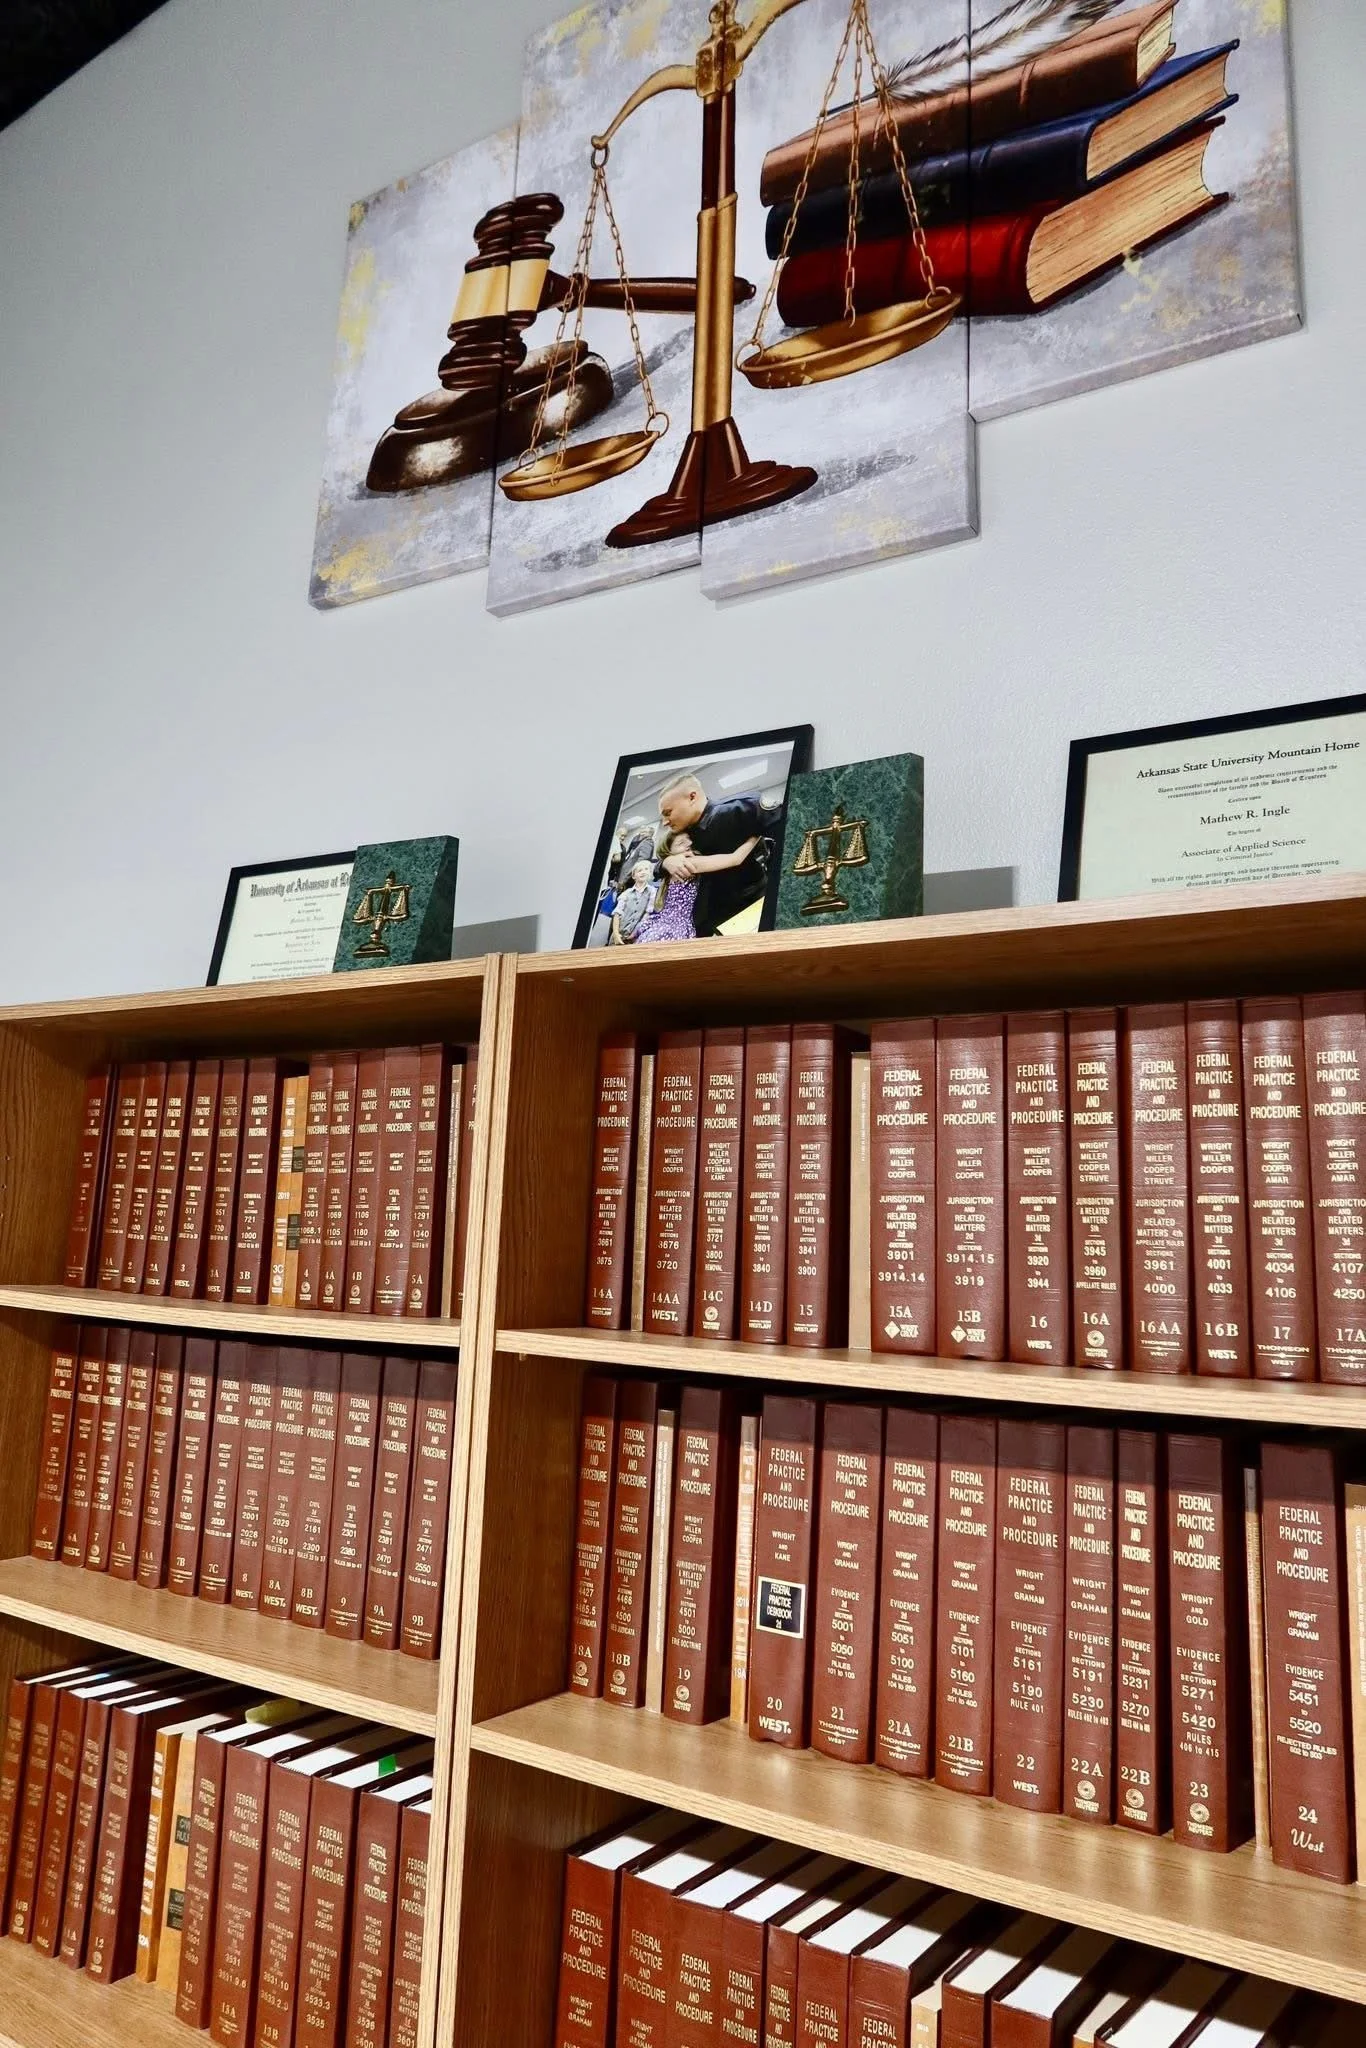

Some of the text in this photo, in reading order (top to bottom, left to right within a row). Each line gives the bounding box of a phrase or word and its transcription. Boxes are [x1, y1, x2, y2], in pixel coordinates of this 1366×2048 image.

[1136, 767, 1181, 779] Arkansas
[1183, 762, 1208, 773] State
[1211, 753, 1264, 768] University
[1267, 746, 1321, 760] Mountain
[1325, 741, 1360, 752] Home
[1200, 806, 1290, 825] Mathew R. Ingle
[1181, 848, 1220, 858] Associate
[1234, 842, 1270, 852] Applied
[1273, 838, 1306, 847] Science
[251, 884, 285, 897] University
[295, 878, 329, 892] Arkansas
[1317, 1051, 1357, 1063] FEDERAL
[603, 1077, 626, 1088] FEDERAL
[664, 1076, 692, 1087] FEDERAL
[757, 1073, 778, 1084] FEDERAL
[1015, 1080, 1058, 1092] PRACTICE
[601, 1090, 627, 1102] PRACTICE
[662, 1090, 693, 1101] PRACTICE
[389, 1099, 411, 1109] PRACTICE
[715, 1104, 726, 1114] AND
[895, 1100, 909, 1110] AND
[704, 1117, 737, 1128] PROCEDURE
[1011, 1111, 1064, 1124] PROCEDURE
[1074, 1112, 1113, 1125] PROCEDURE
[386, 1123, 412, 1132] PROCEDURE
[890, 1159, 914, 1167] MILLER
[956, 1171, 984, 1179] COOPER
[1266, 1176, 1288, 1184] AMAR
[1253, 1200, 1304, 1208] JURISDICTION
[753, 1243, 770, 1252] 3801
[799, 1245, 816, 1255] 3841
[946, 1253, 994, 1264] 3914.15
[273, 1264, 284, 1273] 3C
[798, 1266, 816, 1276] 3900
[1144, 1260, 1174, 1270] 3961
[1207, 1260, 1231, 1270] 4001
[1332, 1263, 1363, 1273] 4107
[304, 1269, 309, 1277] 4
[412, 1274, 423, 1284] 5A
[385, 1276, 390, 1285] 5
[955, 1275, 984, 1286] 3919
[593, 1287, 613, 1299] 14A
[1144, 1284, 1175, 1294] 4000
[652, 1293, 680, 1304] 14AA
[703, 1290, 723, 1302] 14C
[749, 1301, 772, 1313] 14D
[800, 1304, 813, 1316] 15
[889, 1305, 913, 1319] 15A
[1029, 1316, 1047, 1328] 16
[1083, 1313, 1109, 1325] 16A
[1140, 1321, 1181, 1335] 16AA
[1205, 1323, 1238, 1336] 16B
[1273, 1326, 1290, 1339] 17
[251, 1384, 271, 1394] FEDERAL
[283, 1387, 302, 1398] FEDERAL
[312, 1404, 333, 1416] PRACTICE
[388, 1402, 408, 1414] FEDERAL
[427, 1408, 447, 1420] FEDERAL
[349, 1411, 369, 1423] PRACTICE
[387, 1415, 407, 1427] PRACTICE
[245, 1419, 272, 1430] PROCEDURE
[276, 1423, 304, 1435] PROCEDURE
[307, 1429, 334, 1440] PROCEDURE
[625, 1428, 645, 1442] FEDERAL
[345, 1435, 370, 1447] PROCEDURE
[422, 1447, 447, 1459] PROCEDURE
[623, 1442, 645, 1457] PRACTICE
[685, 1451, 709, 1466] PRACTICE
[838, 1455, 867, 1470] FEDERAL
[894, 1463, 925, 1478] FEDERAL
[619, 1473, 647, 1489] PROCEDURE
[950, 1487, 983, 1504] PRACTICE
[763, 1493, 809, 1512] PROCEDURE
[242, 1512, 258, 1520] 2001
[1023, 1516, 1037, 1526] AND
[273, 1518, 290, 1528] 2029
[303, 1542, 320, 1552] 2300
[775, 1552, 790, 1562] KANE
[242, 1573, 247, 1582] 8
[269, 1579, 281, 1590] 8A
[1072, 1578, 1107, 1590] WRIGHT
[301, 1588, 312, 1598] 8B
[341, 1598, 346, 1607] 9
[890, 1599, 919, 1612] EVIDENCE
[1071, 1601, 1108, 1614] GRAHAM
[374, 1606, 384, 1616] 9A
[679, 1607, 696, 1618] 4501
[412, 1615, 424, 1626] 9B
[832, 1619, 853, 1632] 5001
[891, 1632, 914, 1645] 5051
[951, 1644, 974, 1658] 5101
[1013, 1658, 1042, 1672] 5161
[678, 1669, 690, 1680] 19
[950, 1668, 974, 1682] 5160
[1123, 1675, 1149, 1690] 5231
[1182, 1686, 1214, 1701] 5271
[1289, 1690, 1319, 1706] 5451
[767, 1697, 782, 1710] 20
[1122, 1701, 1150, 1717] 5270
[832, 1707, 845, 1720] 21
[1182, 1713, 1216, 1730] 5420
[1289, 1717, 1321, 1734] 5520
[1017, 1754, 1034, 1770] 22
[1071, 1759, 1104, 1777] 22A
[1121, 1766, 1151, 1785] 22B
[1190, 1782, 1209, 1798] 23
[236, 1793, 258, 1807] FEDERAL
[234, 1805, 258, 1823] PRACTICE
[279, 1810, 300, 1827] FEDERAL
[1299, 1806, 1318, 1823] 24
[277, 1823, 300, 1842] PRACTICE
[316, 1840, 343, 1859] PRACTICE
[312, 1866, 344, 1887] PROCEDURE
[571, 1909, 603, 1930] FEDERAL
[569, 1925, 603, 1947] PRACTICE
[579, 1945, 592, 1957] AND
[563, 1953, 606, 1979] PROCEDURE
[680, 1971, 711, 1992] PRACTICE
[728, 1970, 754, 1990] FEDERAL
[727, 1987, 754, 2008] PRACTICE
[806, 2001, 838, 2023] FEDERAL
[722, 2021, 758, 2042] PROCEDURE
